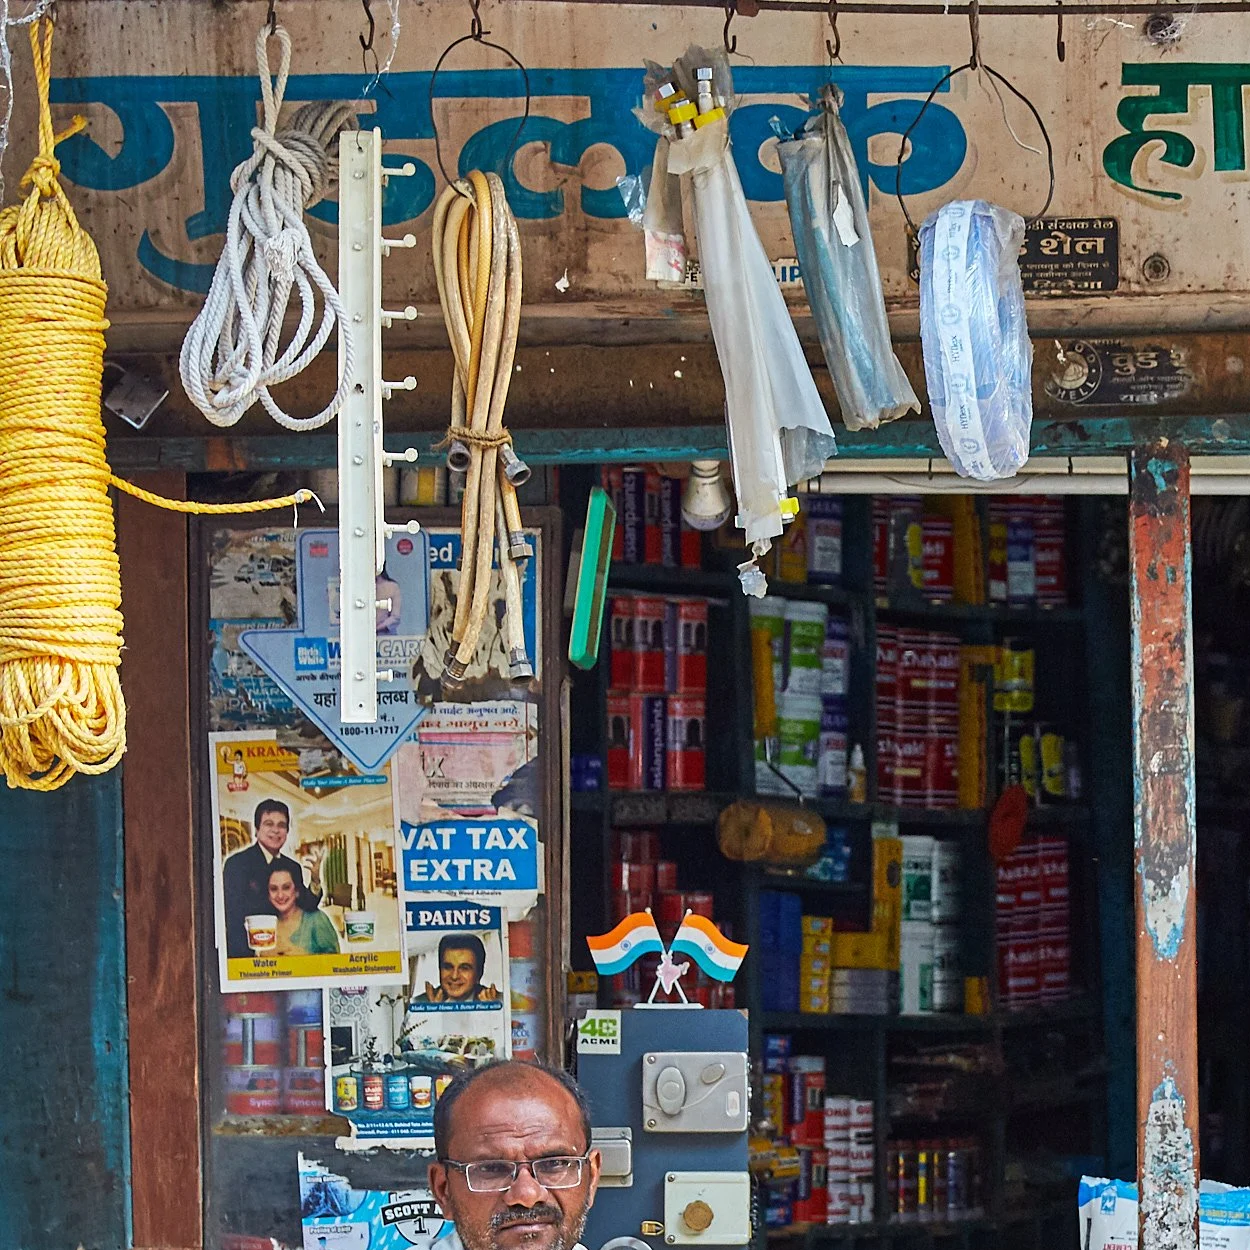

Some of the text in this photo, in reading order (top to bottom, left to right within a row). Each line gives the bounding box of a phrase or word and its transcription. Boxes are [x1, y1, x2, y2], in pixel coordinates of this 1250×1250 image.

[340, 725, 399, 736] 1800-11-1717
[400, 827, 529, 850] VAT TAX
[410, 859, 517, 881] EXTRA
[419, 909, 491, 926] PAINTS
[253, 953, 379, 968] Water Acrylic
[384, 1203, 431, 1221] SCOTT
[414, 1216, 427, 1234] 1
